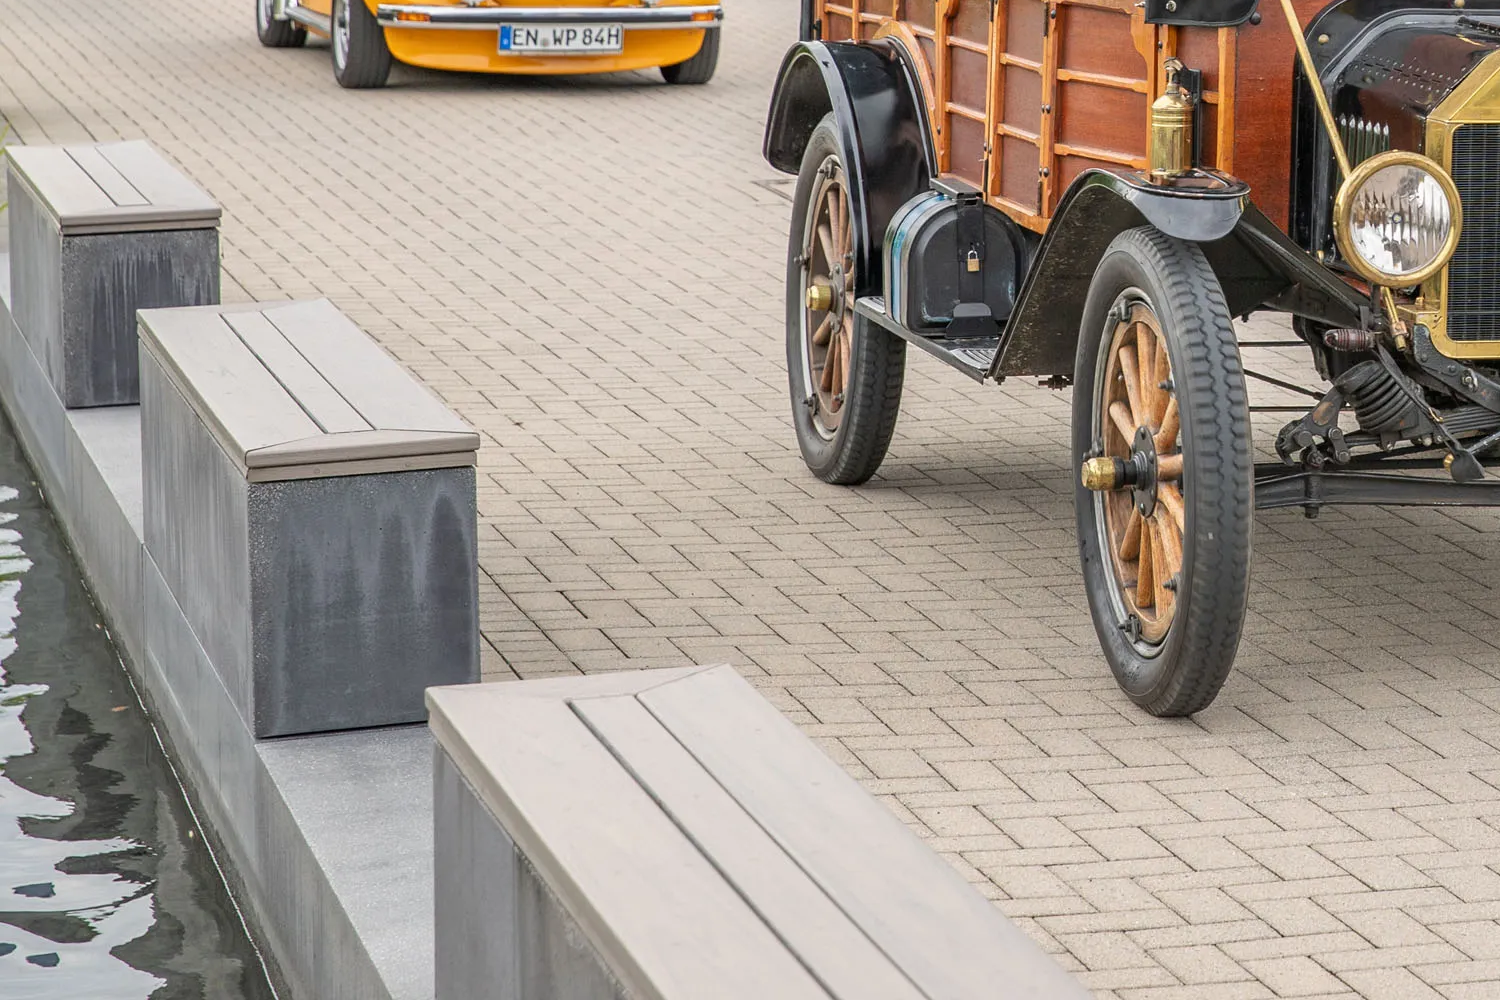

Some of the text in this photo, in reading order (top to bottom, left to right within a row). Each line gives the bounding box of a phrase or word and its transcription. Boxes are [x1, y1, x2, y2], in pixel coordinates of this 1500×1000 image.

[512, 27, 620, 46] EN WP 84H
